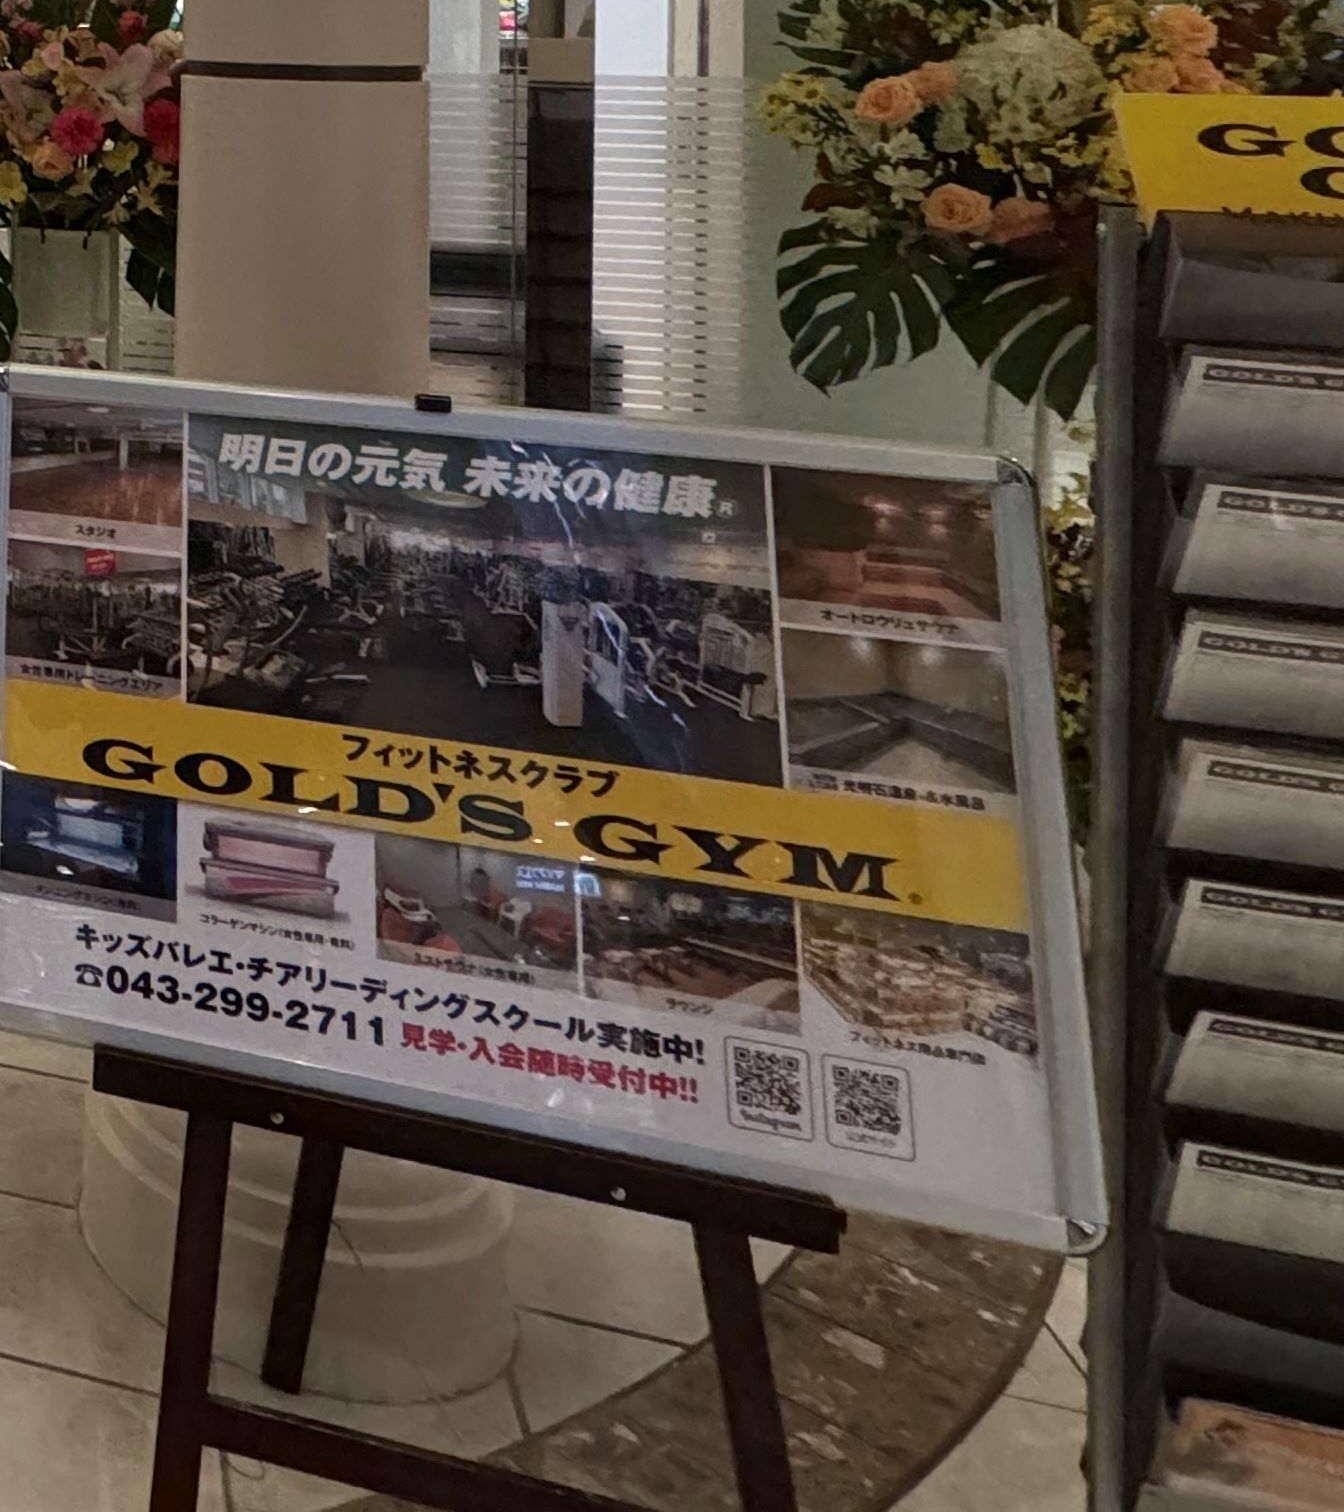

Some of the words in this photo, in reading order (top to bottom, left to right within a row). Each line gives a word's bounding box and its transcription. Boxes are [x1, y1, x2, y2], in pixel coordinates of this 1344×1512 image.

[218, 432, 449, 494] 明日の元気
[464, 455, 719, 519] 未来の健康
[75, 524, 117, 539] スタジオ
[342, 732, 621, 797] フィットネスクラブ
[81, 737, 534, 843] GOLD'S
[573, 813, 901, 902] GYM
